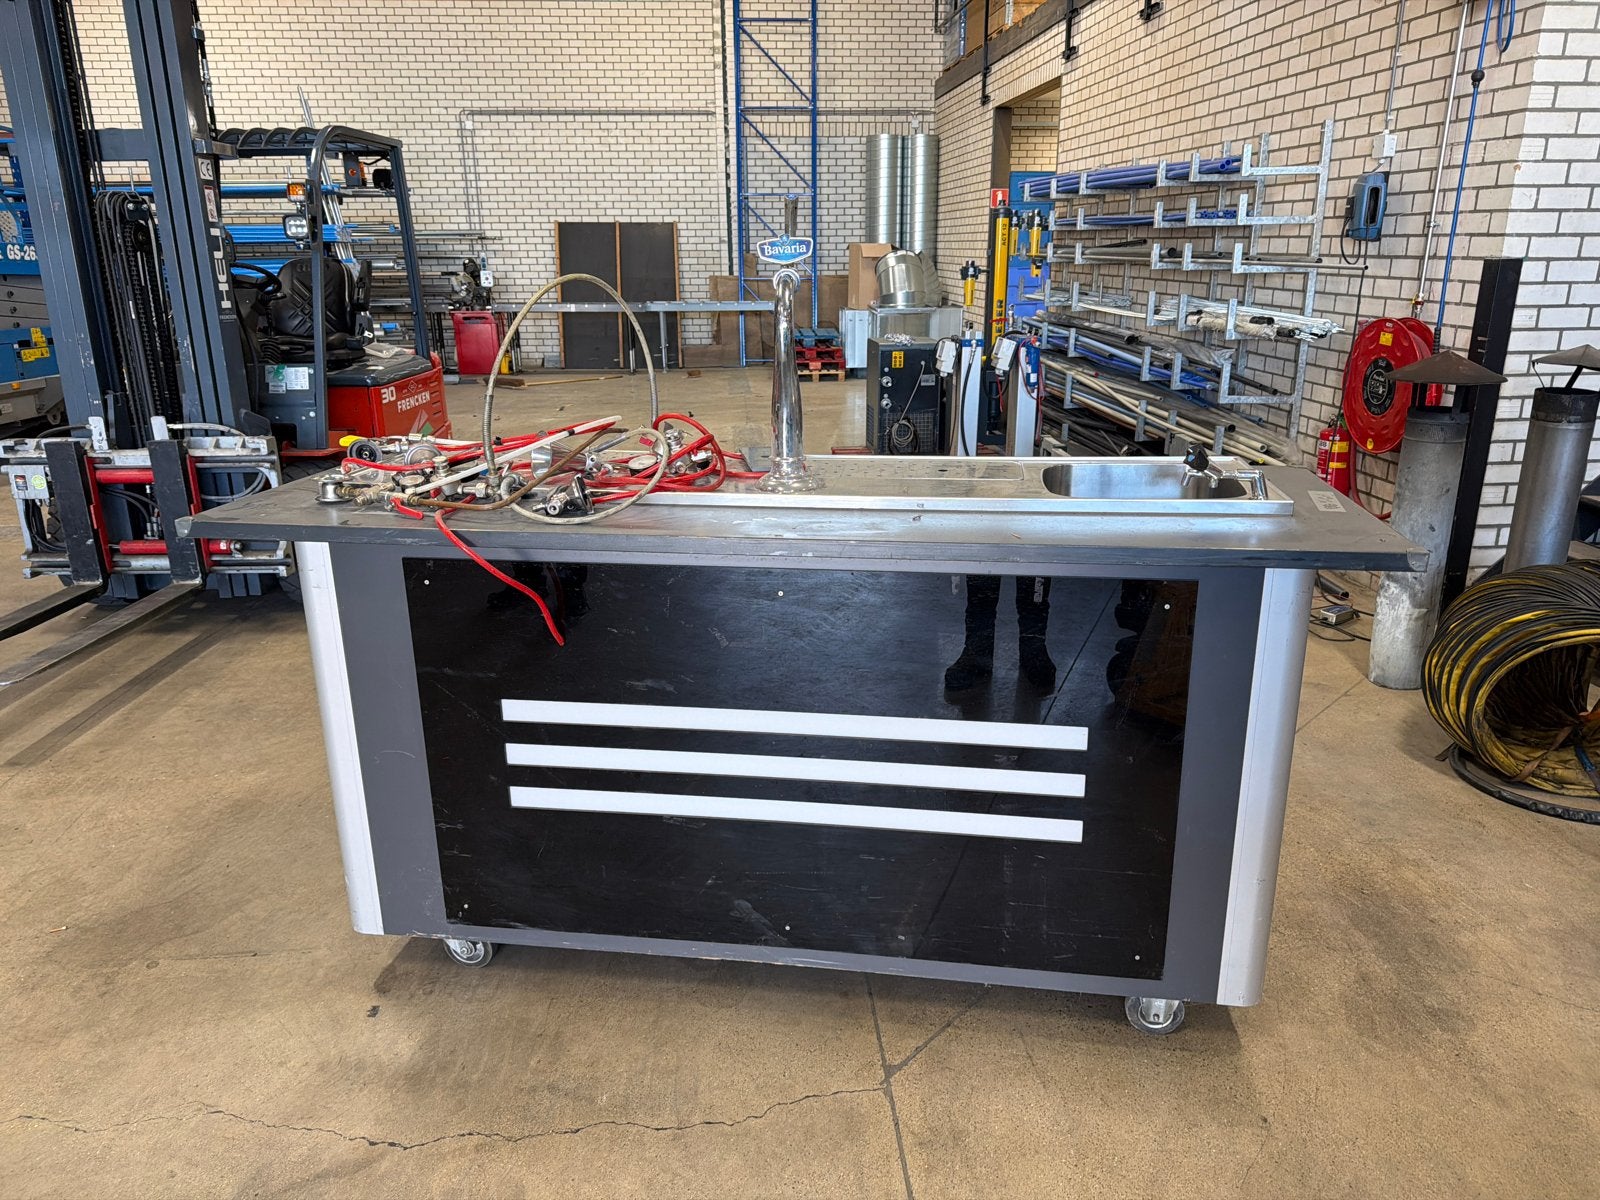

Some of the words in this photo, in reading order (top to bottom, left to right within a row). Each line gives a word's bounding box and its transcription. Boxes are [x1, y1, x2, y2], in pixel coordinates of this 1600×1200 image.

[6, 243, 38, 260] GS-26
[761, 241, 807, 256] Bavaria
[210, 227, 232, 309] HELI
[380, 385, 397, 404] 30
[396, 390, 431, 414] FRENCKEN
